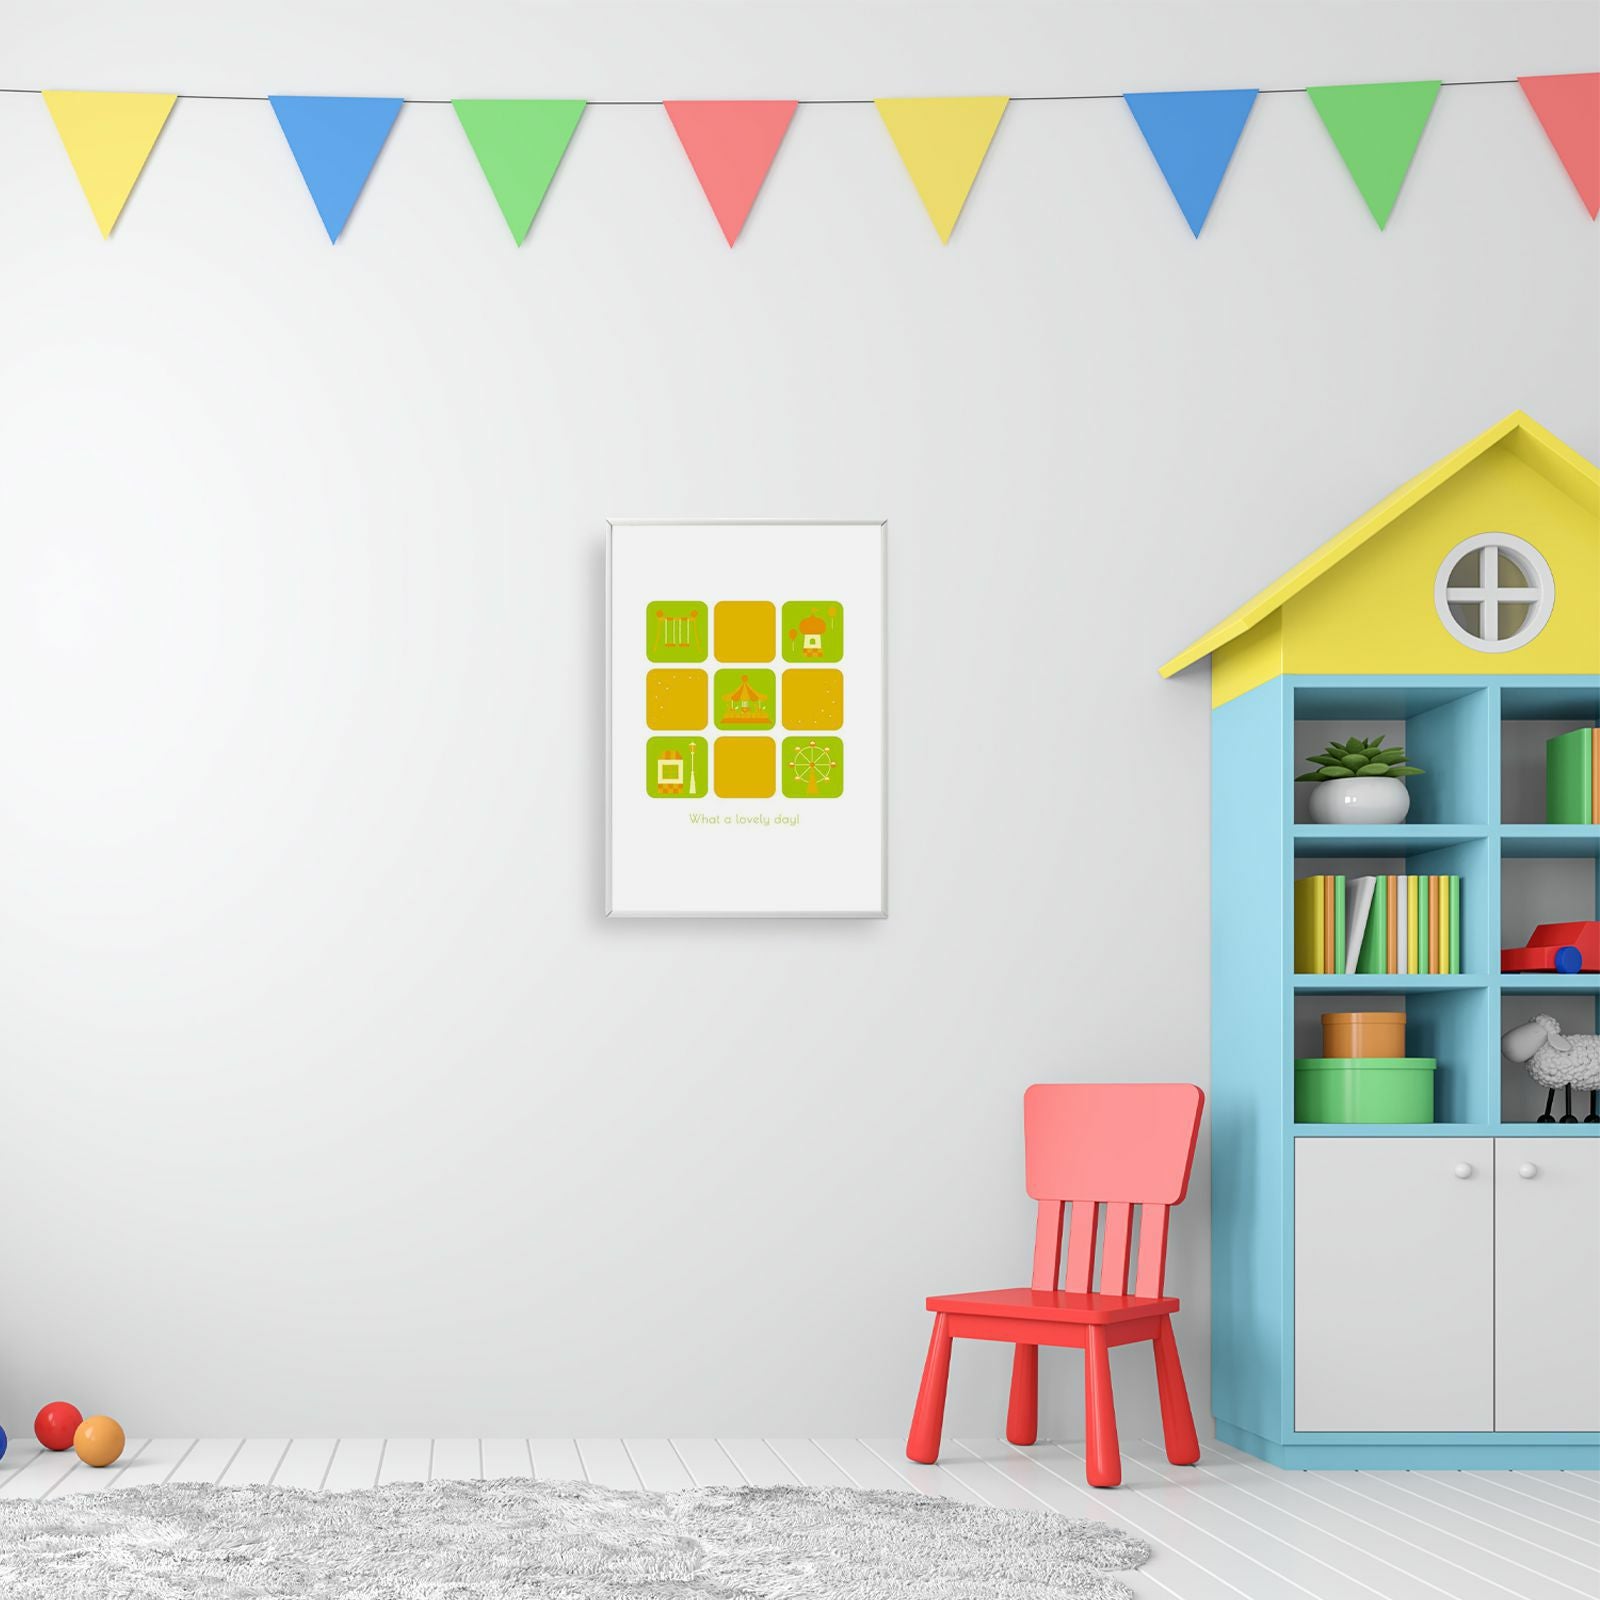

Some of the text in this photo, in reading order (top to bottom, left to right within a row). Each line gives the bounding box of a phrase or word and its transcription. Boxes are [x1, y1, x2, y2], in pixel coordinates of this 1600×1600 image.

[689, 812, 800, 827] What a lovely day!
